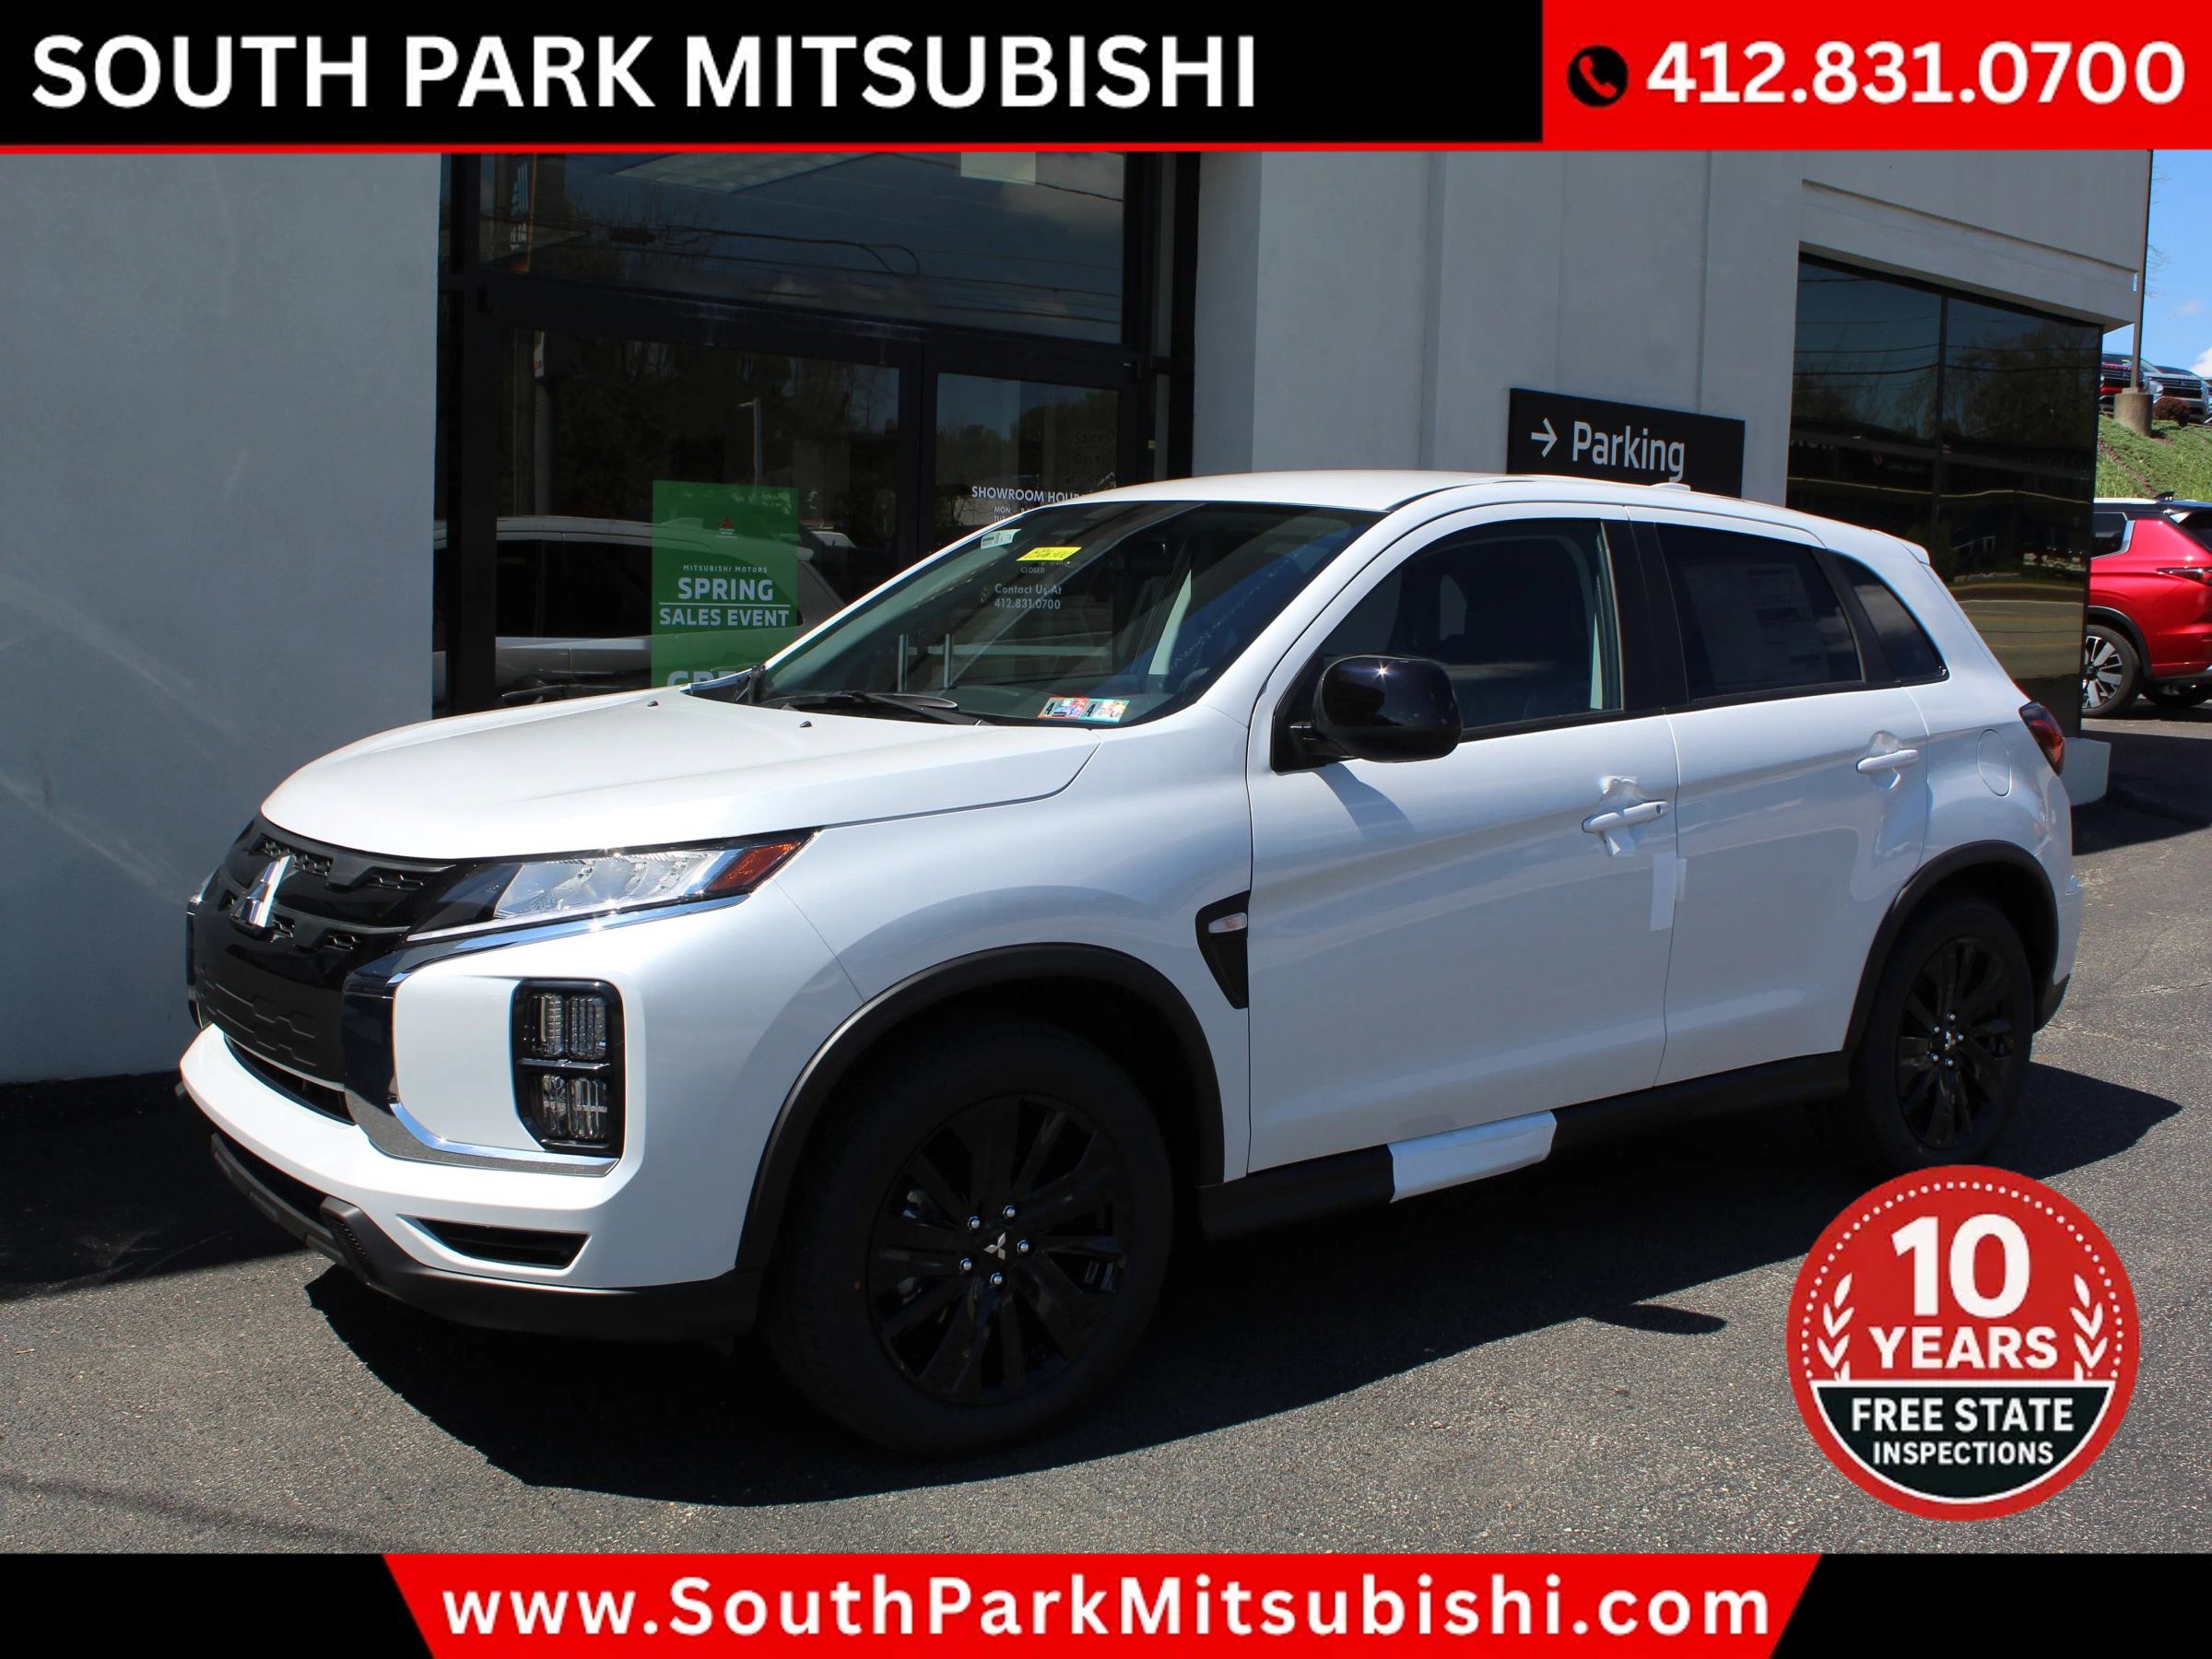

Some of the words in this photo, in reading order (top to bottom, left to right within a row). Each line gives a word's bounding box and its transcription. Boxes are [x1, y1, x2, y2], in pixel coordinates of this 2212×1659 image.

[1571, 420, 1685, 483] Parking
[971, 486, 1044, 502] SHOWROOM
[683, 564, 732, 572] MITSUBISHI
[1020, 566, 1045, 574] CLOSED
[678, 577, 772, 601] SPRING
[994, 582, 1032, 594] Contact
[994, 597, 1061, 610] 412.831.0700
[659, 607, 721, 626] SALES
[727, 608, 790, 627] EVENT
